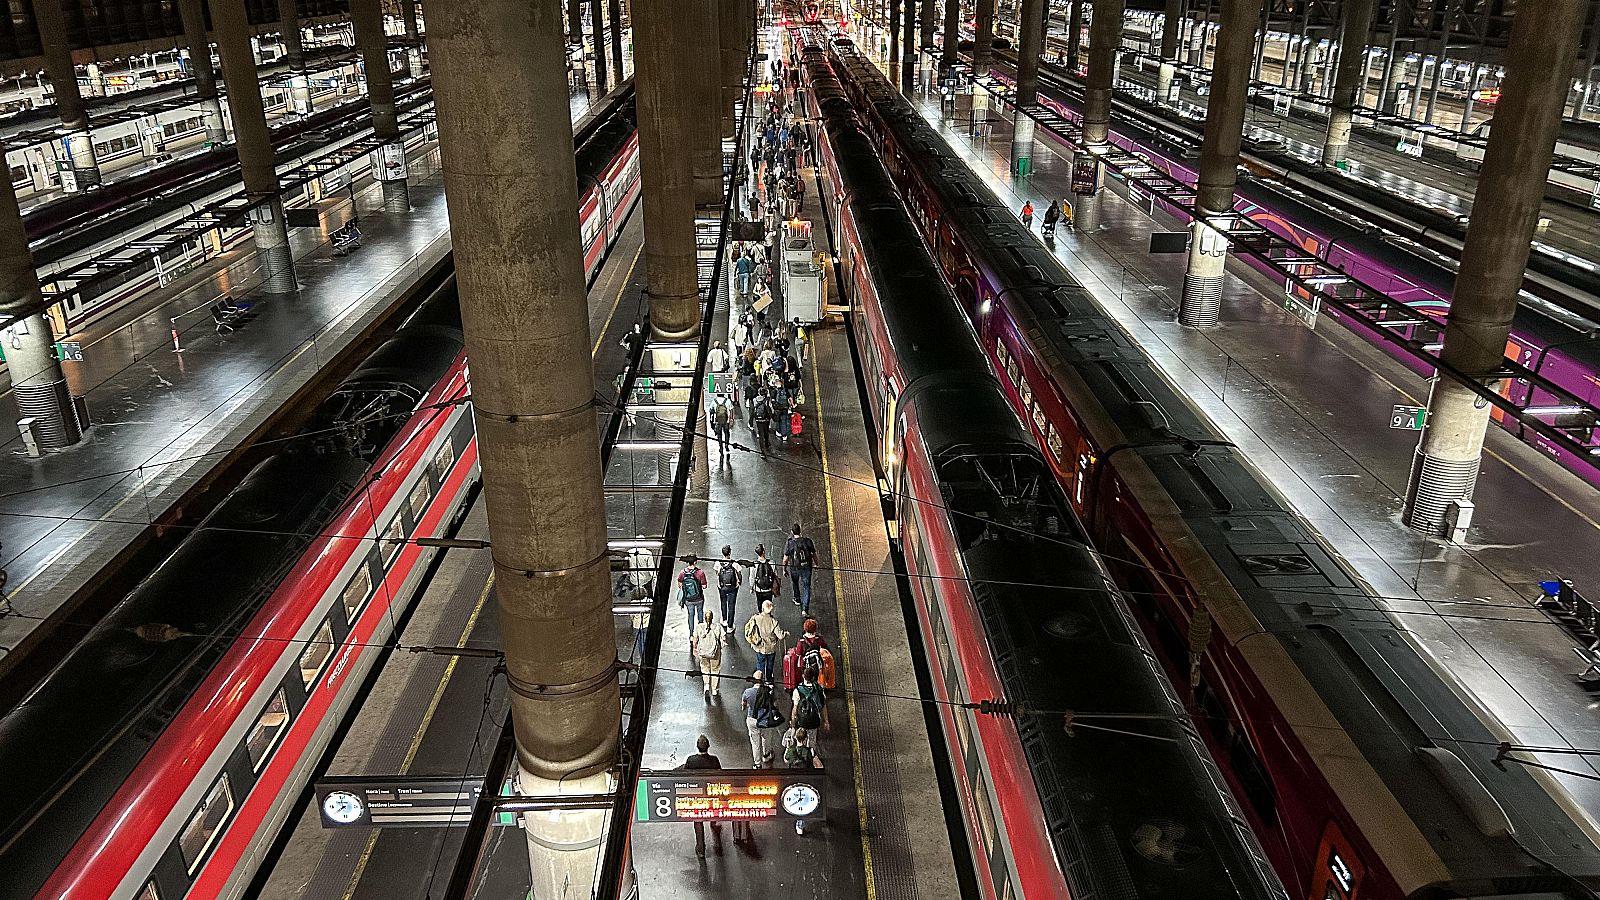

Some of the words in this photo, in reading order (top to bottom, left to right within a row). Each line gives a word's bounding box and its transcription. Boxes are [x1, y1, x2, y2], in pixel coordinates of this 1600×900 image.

[64, 350, 71, 360] A
[75, 350, 82, 360] 6
[714, 382, 722, 393] A
[726, 382, 733, 393] 8
[1393, 415, 1402, 427] 9
[1405, 417, 1416, 428] A
[655, 796, 672, 817] 8
